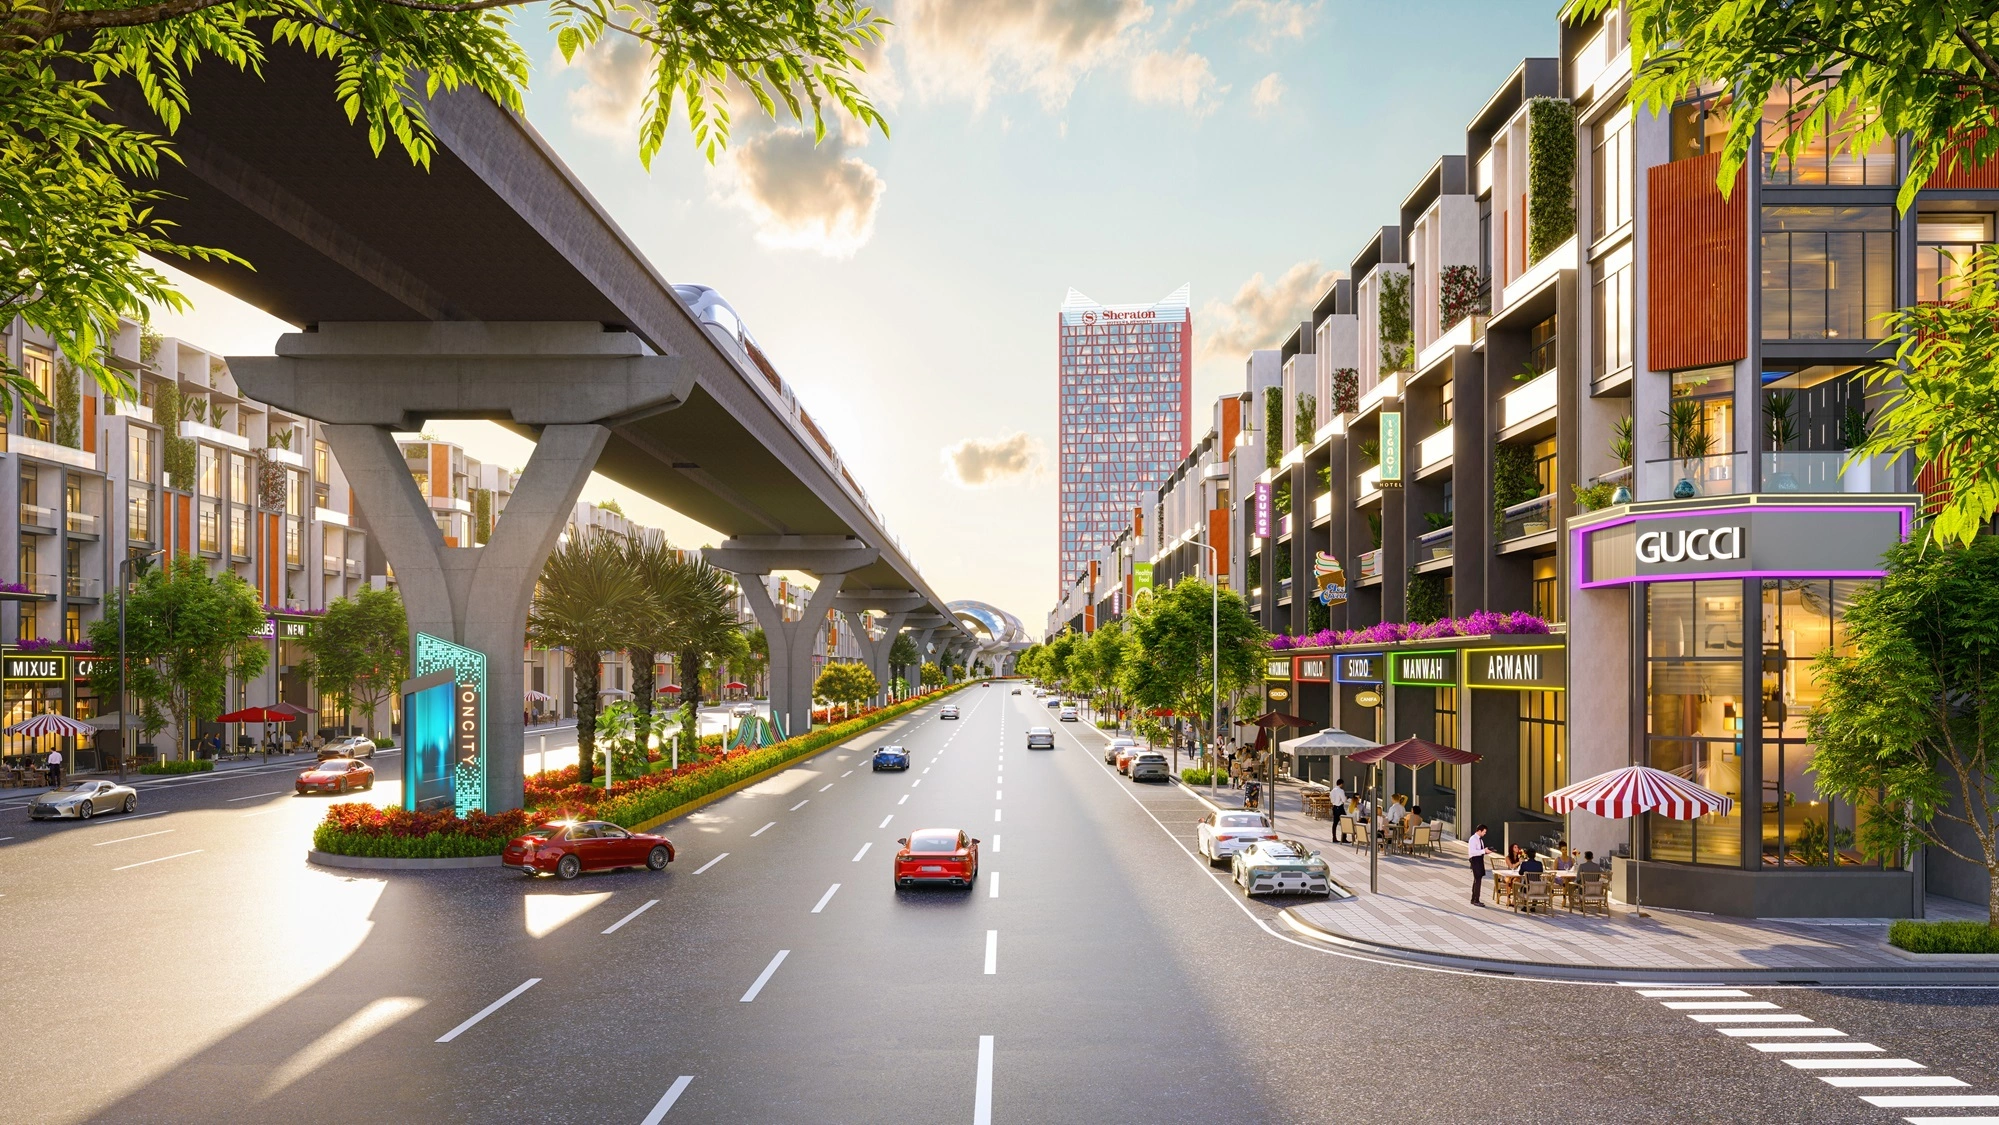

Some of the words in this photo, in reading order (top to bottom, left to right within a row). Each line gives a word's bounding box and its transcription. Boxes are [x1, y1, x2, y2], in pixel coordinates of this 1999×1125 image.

[1102, 309, 1156, 321] Sheraton
[1386, 419, 1395, 474] LEGACY
[1258, 485, 1267, 535] LOUNGE
[1636, 526, 1741, 563] GUCCI
[13, 661, 57, 676] MIXUE
[1349, 659, 1369, 677] SIXDO
[1403, 658, 1442, 679] MANWAH
[1488, 654, 1538, 680] ARMANI
[462, 684, 475, 765] IONCITY
